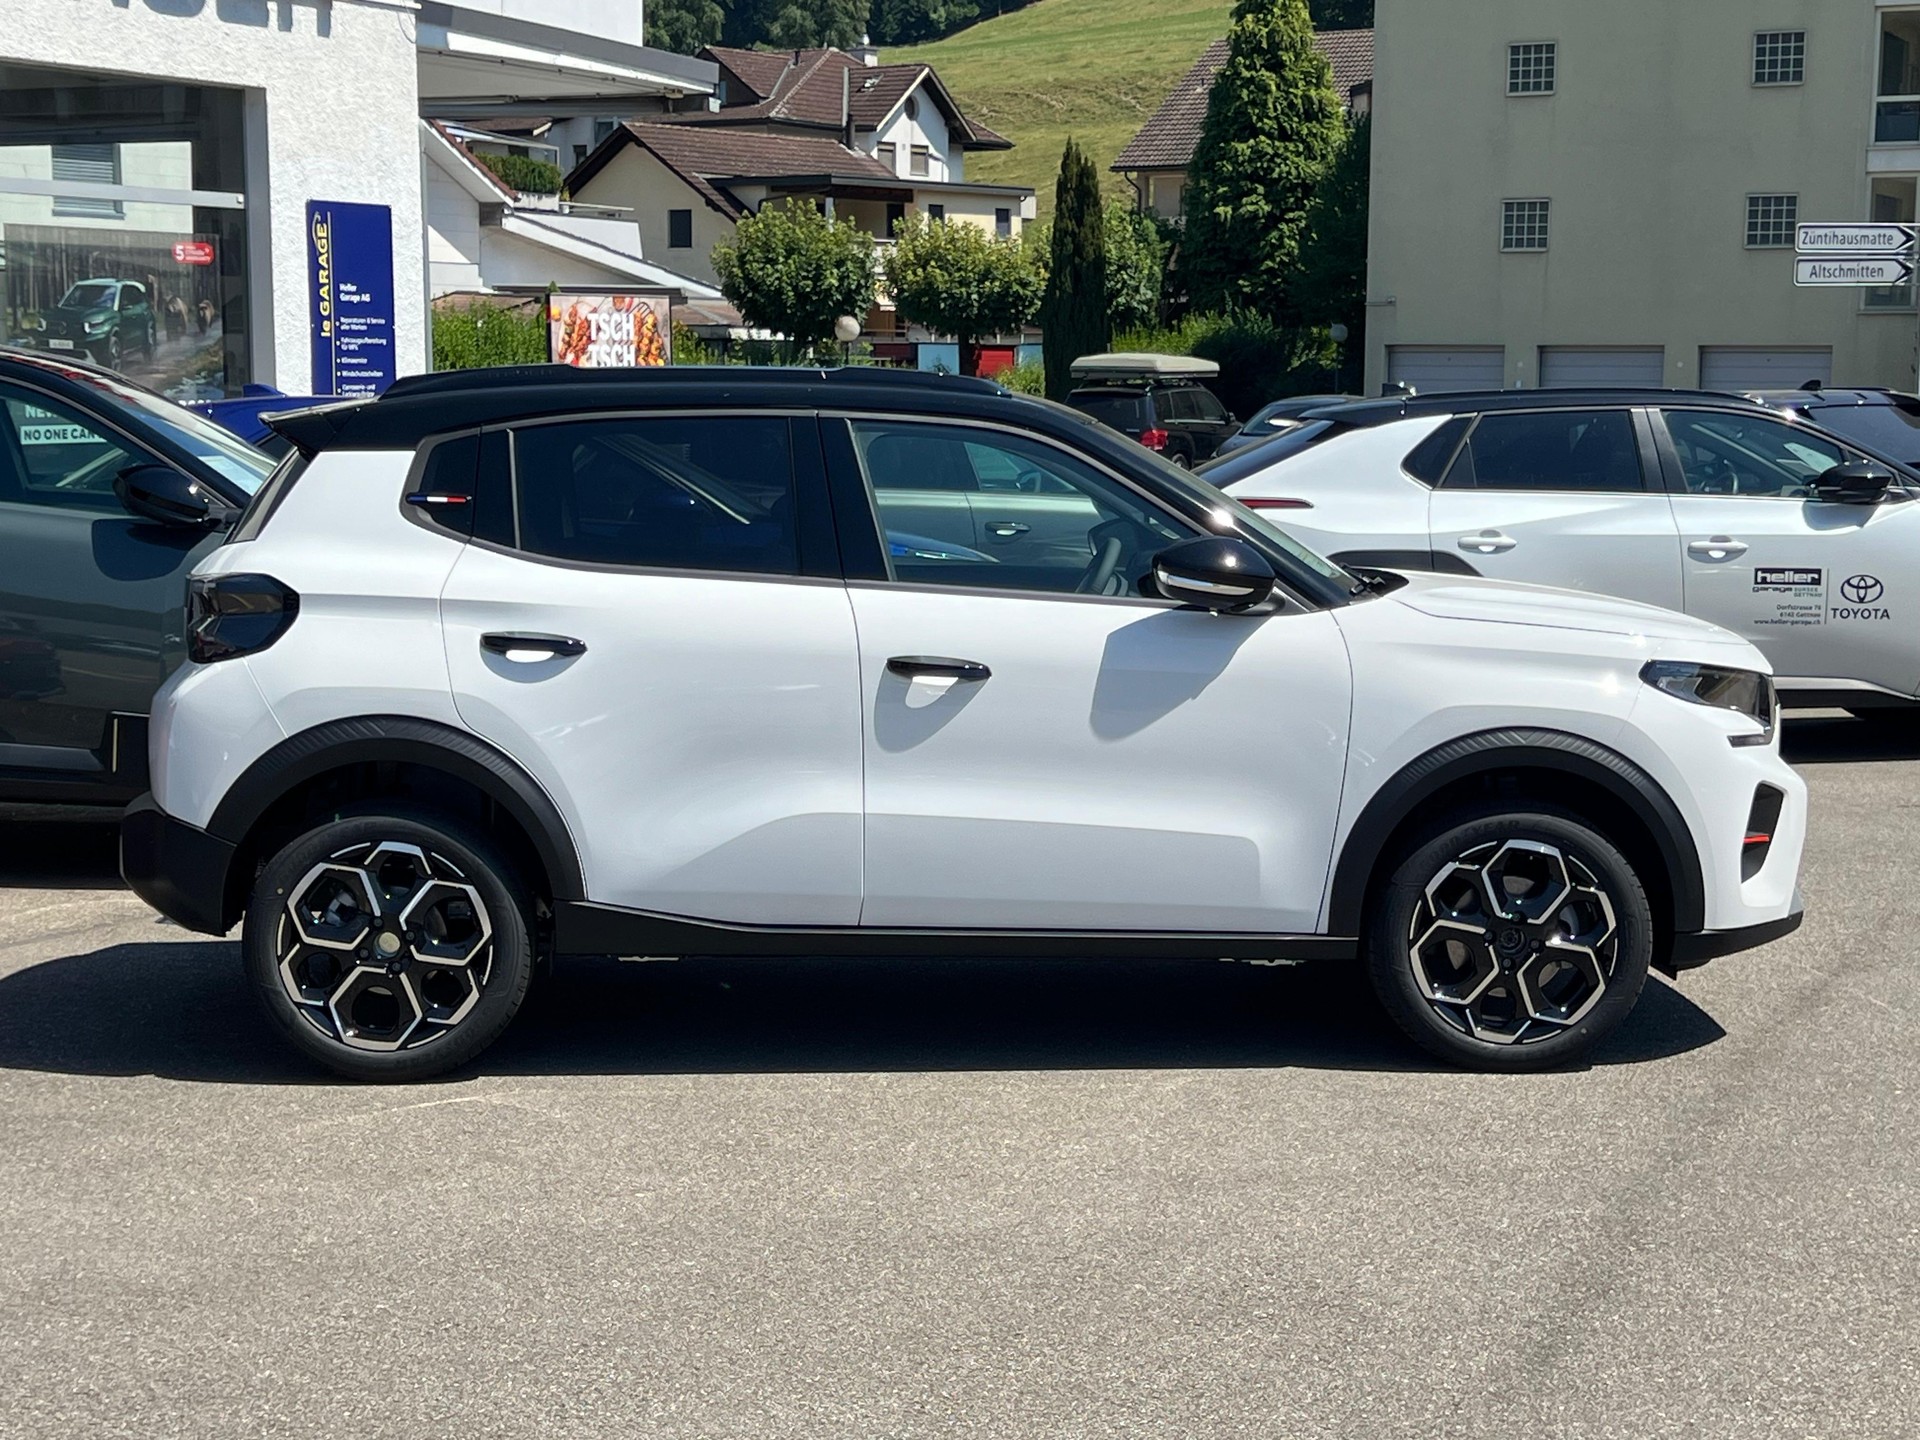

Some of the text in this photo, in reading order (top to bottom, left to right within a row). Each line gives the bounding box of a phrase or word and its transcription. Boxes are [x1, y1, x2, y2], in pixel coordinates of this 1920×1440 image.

[1802, 230, 1894, 246] Züntihausmatte
[175, 244, 185, 261] 5
[1809, 263, 1884, 279] Altschmitten
[316, 222, 332, 337] le GARAGE
[339, 283, 357, 292] Heller
[339, 292, 371, 303] Garage AG
[587, 312, 635, 341] TSCH
[588, 344, 636, 366] TSCH
[24, 429, 42, 440] NO
[44, 429, 68, 440] ONE
[1757, 570, 1819, 583] heller
[1831, 607, 1891, 621] TOYOTA
[1753, 618, 1821, 626] www.heller-garage.ch
